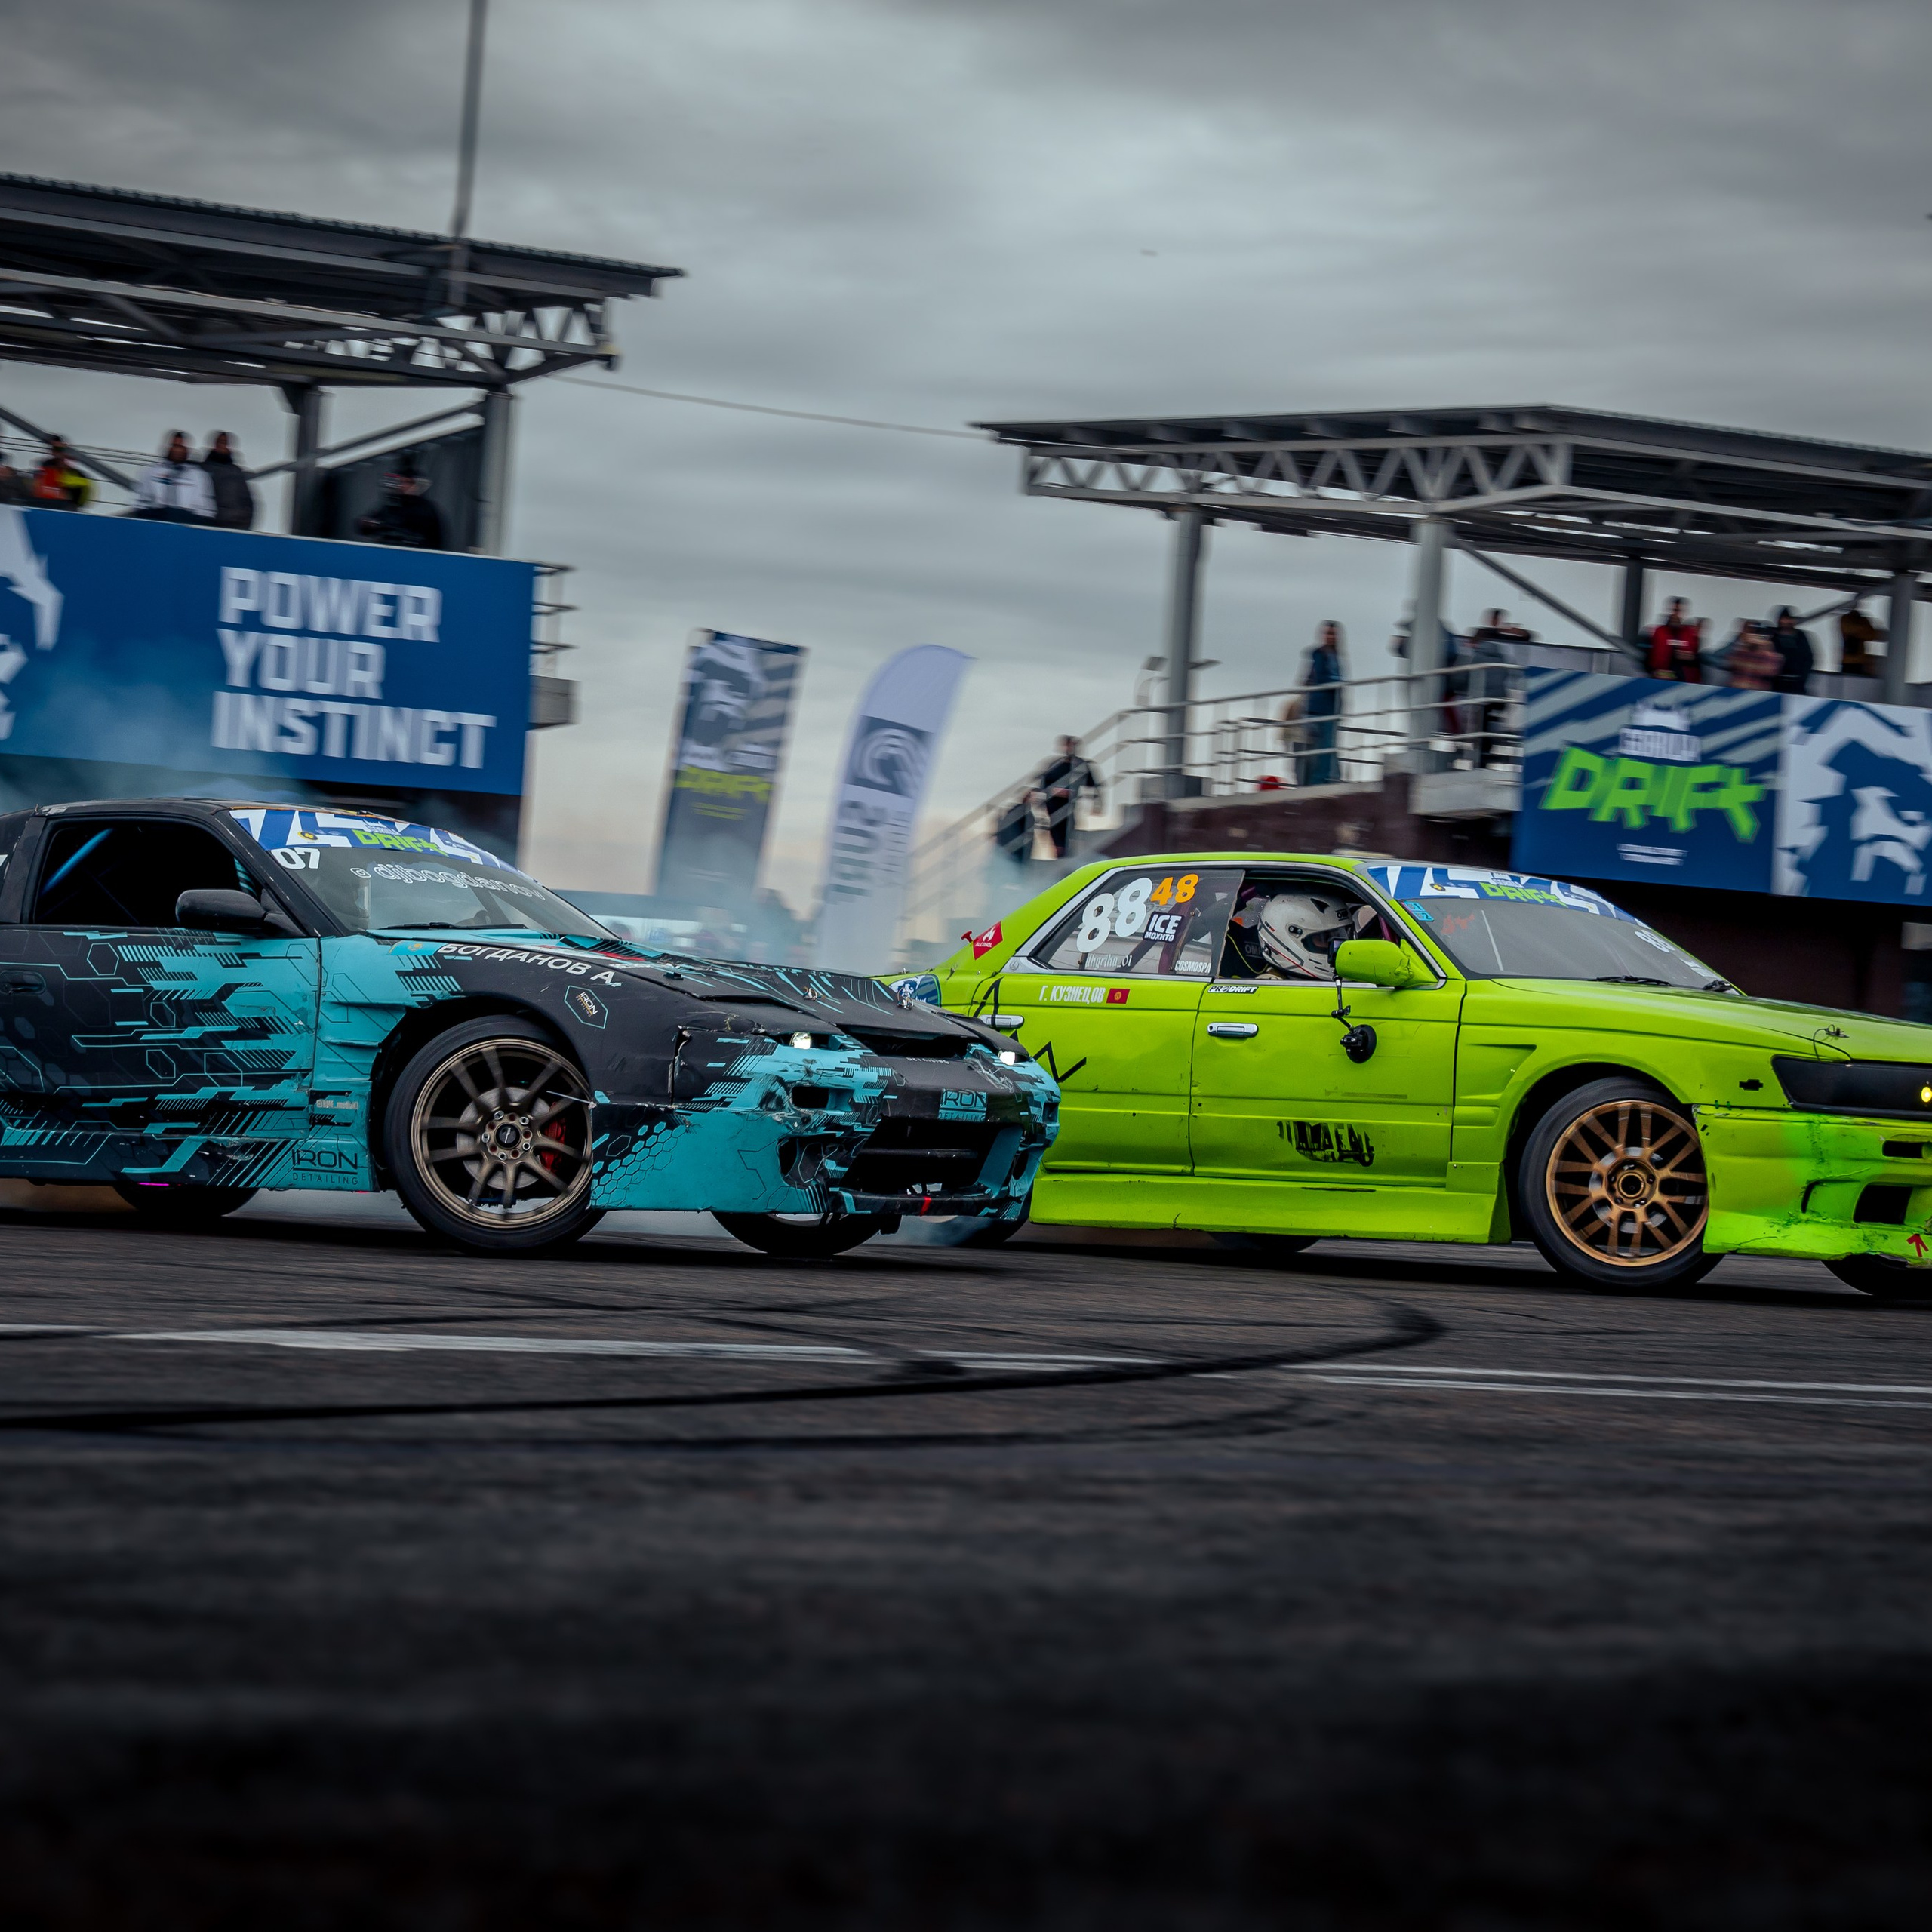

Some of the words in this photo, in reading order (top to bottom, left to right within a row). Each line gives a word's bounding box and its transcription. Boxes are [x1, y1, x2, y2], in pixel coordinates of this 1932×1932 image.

[219, 566, 443, 643] POWER
[216, 628, 387, 699] YOUR
[211, 691, 497, 769] INSTINCT
[1539, 746, 1765, 843] DRIFT
[352, 829, 449, 857] DRIFT
[271, 848, 320, 869] 07
[374, 864, 546, 900] djbogdanov
[1150, 874, 1199, 906] 48
[1479, 882, 1568, 908] DRIFT
[1077, 878, 1152, 954] 88
[1148, 914, 1182, 934] ICE
[1144, 931, 1174, 942] МОХИТО
[1634, 929, 1675, 953] 88
[437, 943, 592, 975] БОГДАНОВ
[580, 992, 598, 1014] IRON
[1038, 986, 1048, 1001] Г.
[1050, 986, 1106, 1004] КУЗНЕЦОВ
[941, 1088, 987, 1108] IRON
[291, 1149, 358, 1170] IRON
[292, 1172, 358, 1185] DETAILING
